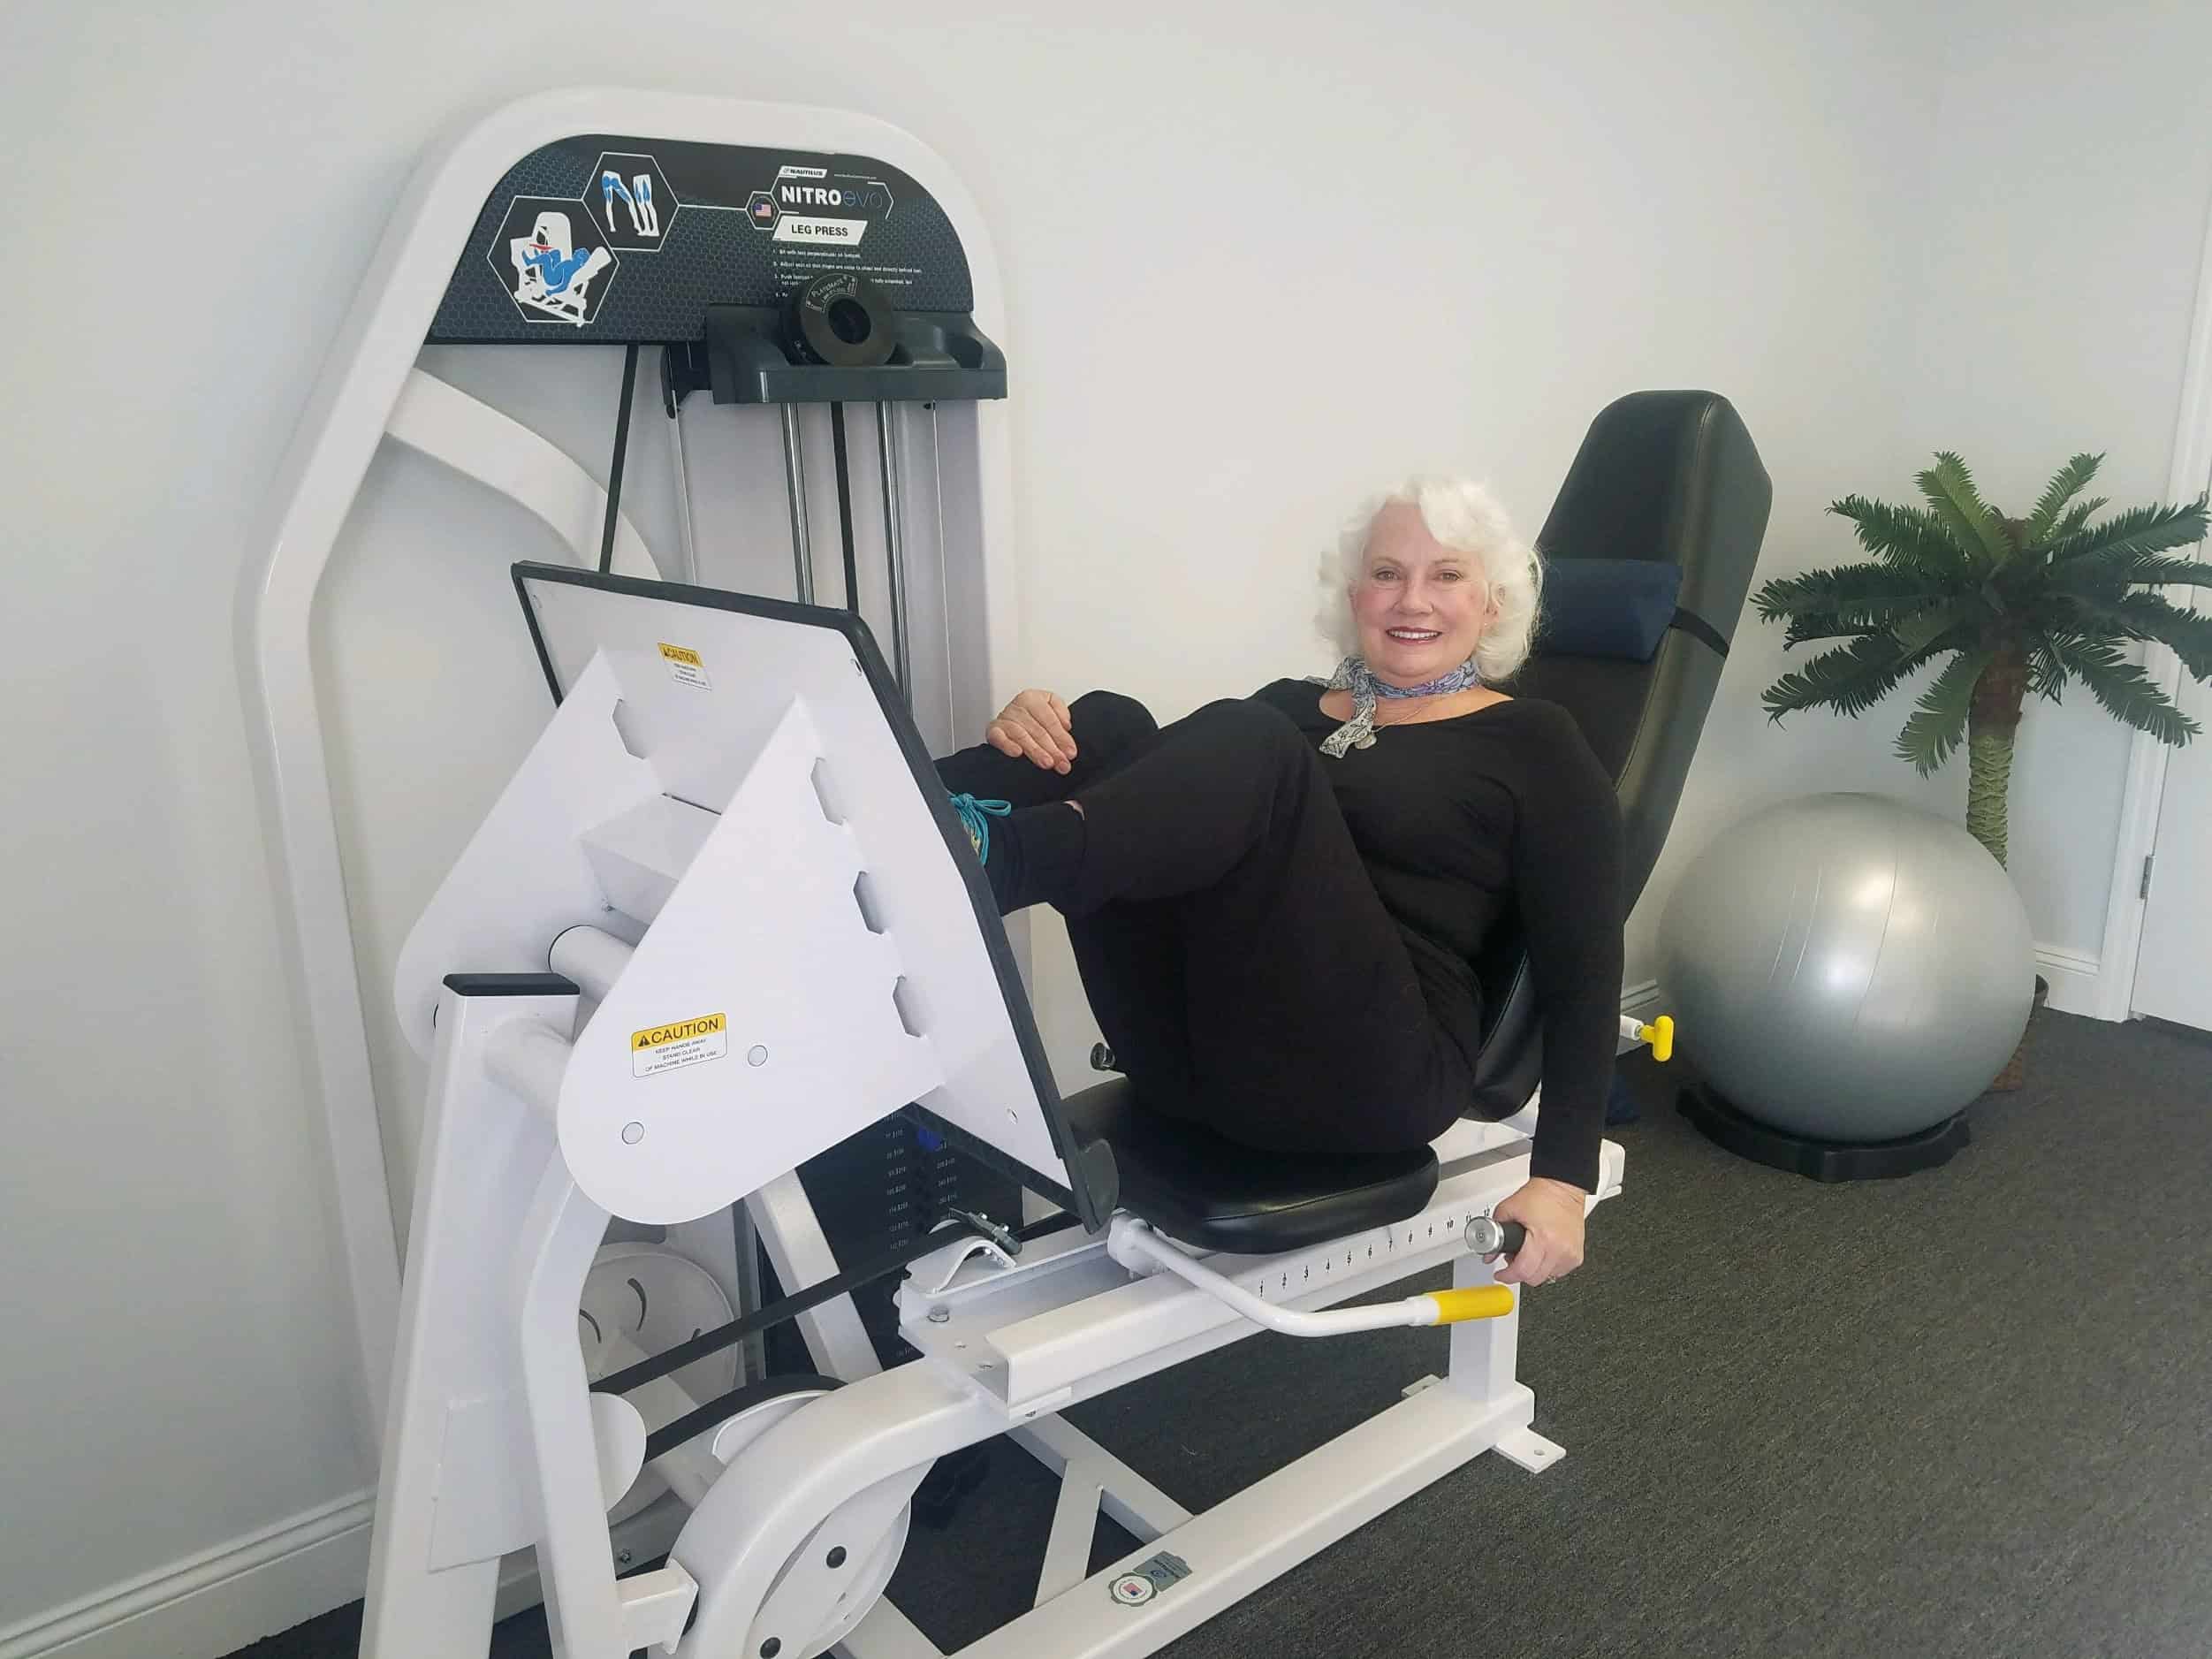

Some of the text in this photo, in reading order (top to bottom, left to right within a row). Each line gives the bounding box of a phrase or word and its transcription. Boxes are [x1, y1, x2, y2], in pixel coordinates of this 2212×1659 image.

[791, 224, 848, 237] LEG PRESS
[666, 647, 699, 665] CAUTION
[651, 1018, 718, 1044] CAUTION
[654, 1060, 680, 1069] MACHINE
